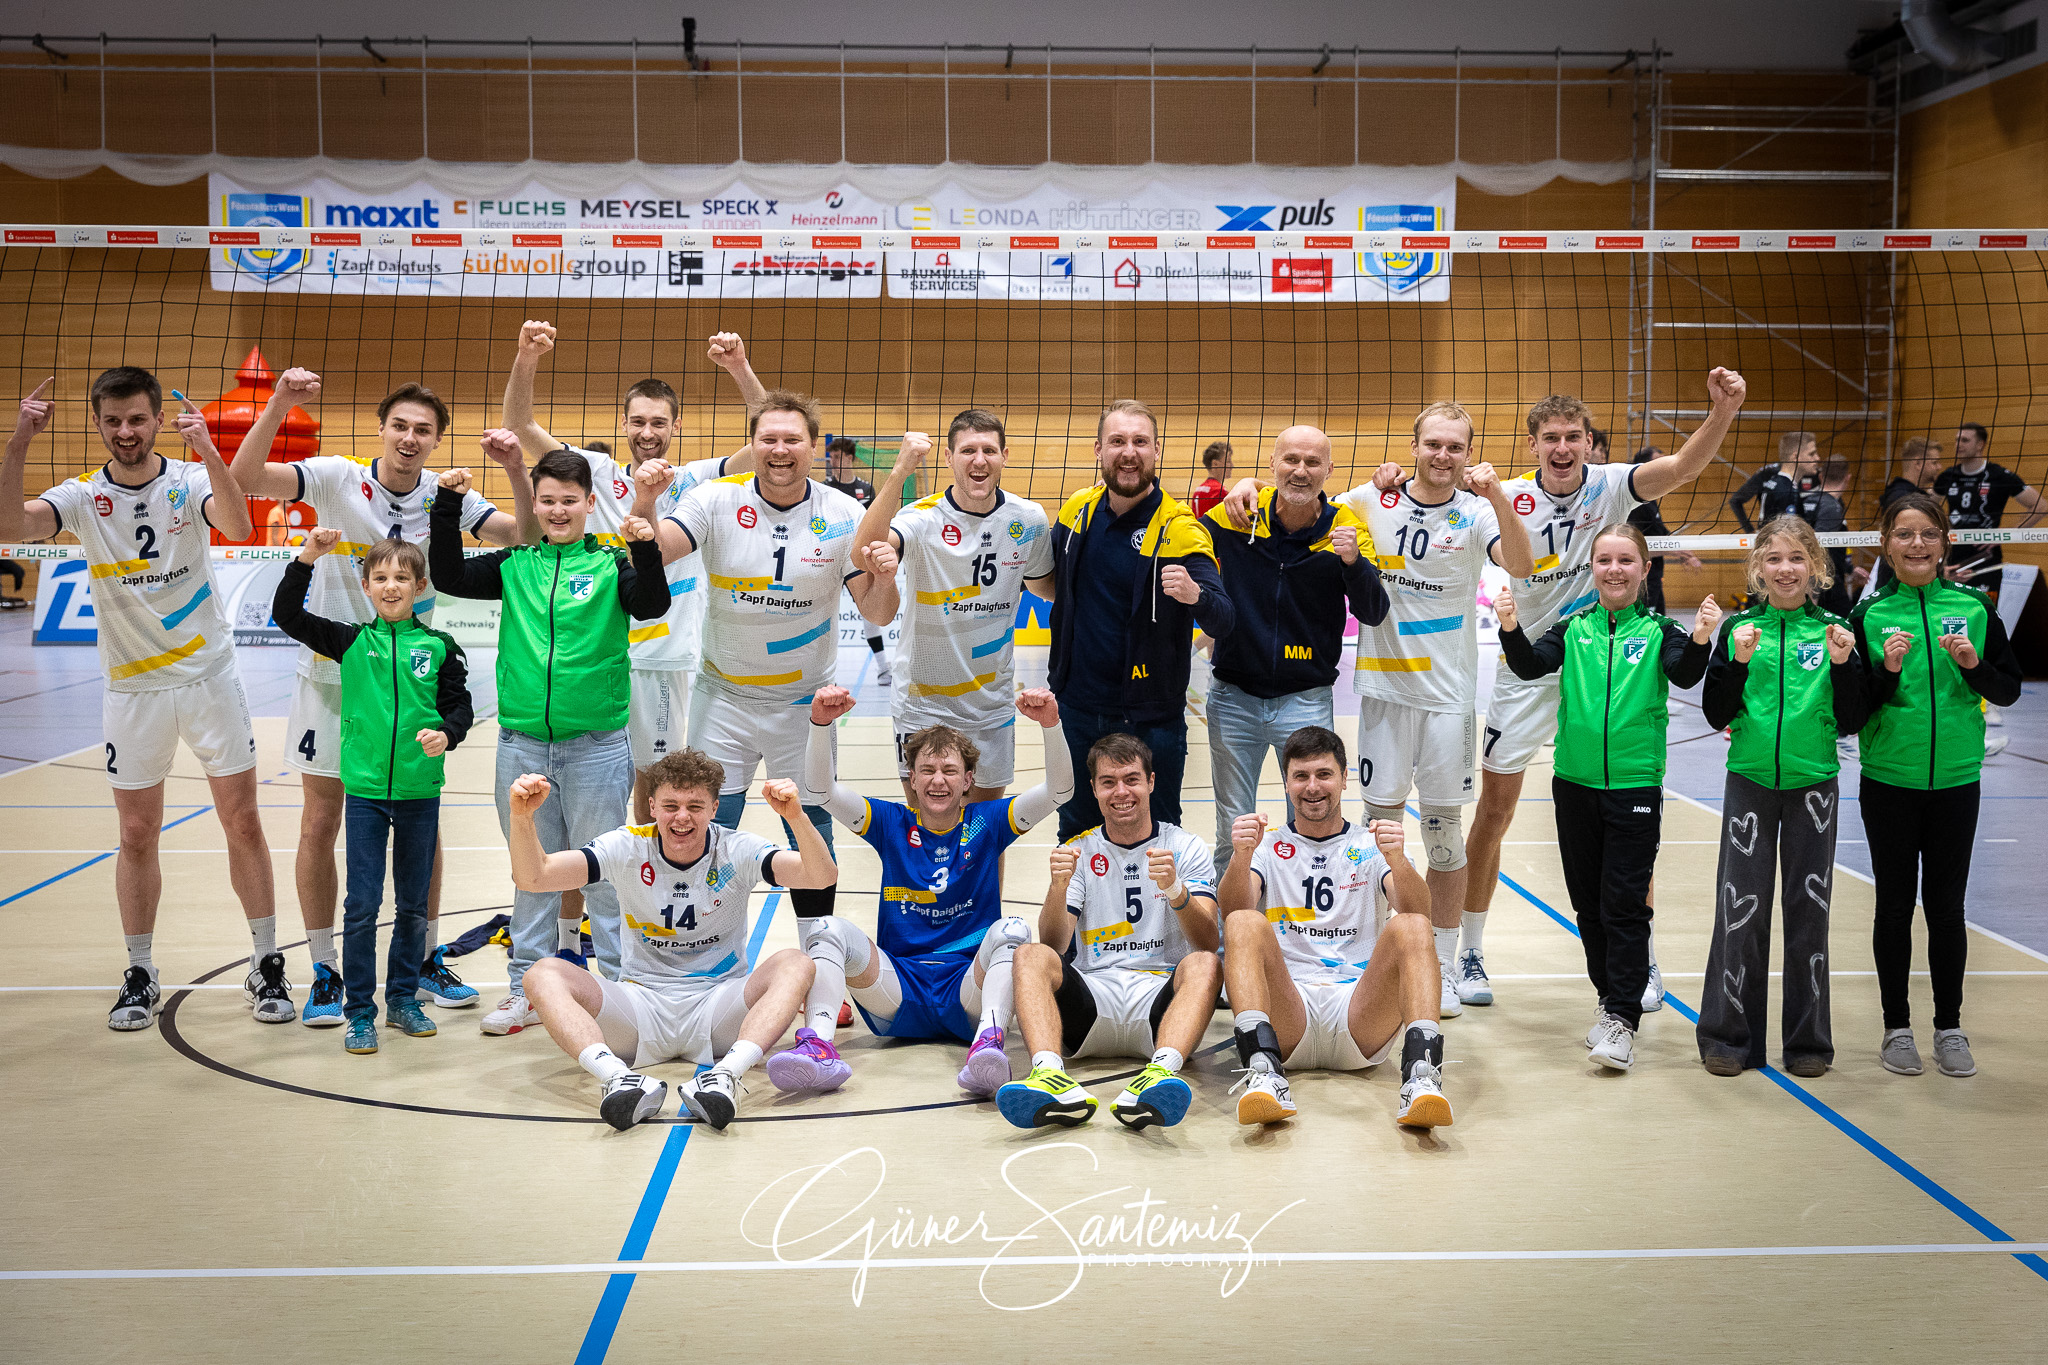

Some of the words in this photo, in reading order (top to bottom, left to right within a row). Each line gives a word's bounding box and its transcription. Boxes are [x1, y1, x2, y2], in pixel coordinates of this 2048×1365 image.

[326, 199, 439, 228] maxit
[480, 200, 566, 215] FUCHS
[581, 200, 690, 218] MEYSEL
[703, 200, 759, 215] SPECK
[1280, 198, 1335, 231] puls
[792, 214, 877, 226] Heinzelmann
[949, 208, 1039, 226] LEONDA
[341, 260, 374, 276] Zapf
[379, 259, 442, 275] Daigfuss
[910, 280, 977, 291] SERVICES
[1409, 516, 1424, 525] errea
[135, 524, 160, 560] 2
[1395, 524, 1430, 560] 10
[1542, 520, 1576, 555] 17
[1648, 540, 1680, 549] setzen
[1964, 532, 2011, 542] FUCHS
[16, 548, 68, 557] FUCHS
[240, 551, 291, 559] FUCHS
[772, 546, 786, 581] 1
[972, 553, 997, 586] 15
[146, 564, 189, 584] Daigfuss
[1532, 574, 1554, 584] Zapf
[1556, 562, 1590, 580] Daigfus
[1398, 576, 1444, 592] Daigfuss
[740, 592, 765, 605] Zapf
[766, 596, 812, 609] Daigfuss
[952, 602, 973, 613] Zapf
[975, 602, 1010, 612] Daigfuss
[446, 621, 495, 629] Schwaig
[1284, 644, 1312, 660] MM
[1131, 664, 1149, 680] AL
[298, 729, 316, 762] 4
[105, 742, 118, 774] 2
[929, 867, 949, 894] 3
[1302, 876, 1334, 912] 16
[910, 902, 930, 918] Zapf
[1126, 886, 1143, 924] 5
[660, 904, 697, 931] 14
[1289, 921, 1308, 934] Zapf
[1310, 928, 1358, 939] Daigfuss
[1103, 942, 1128, 952] Zapf
[1130, 939, 1164, 952] Daigfus
